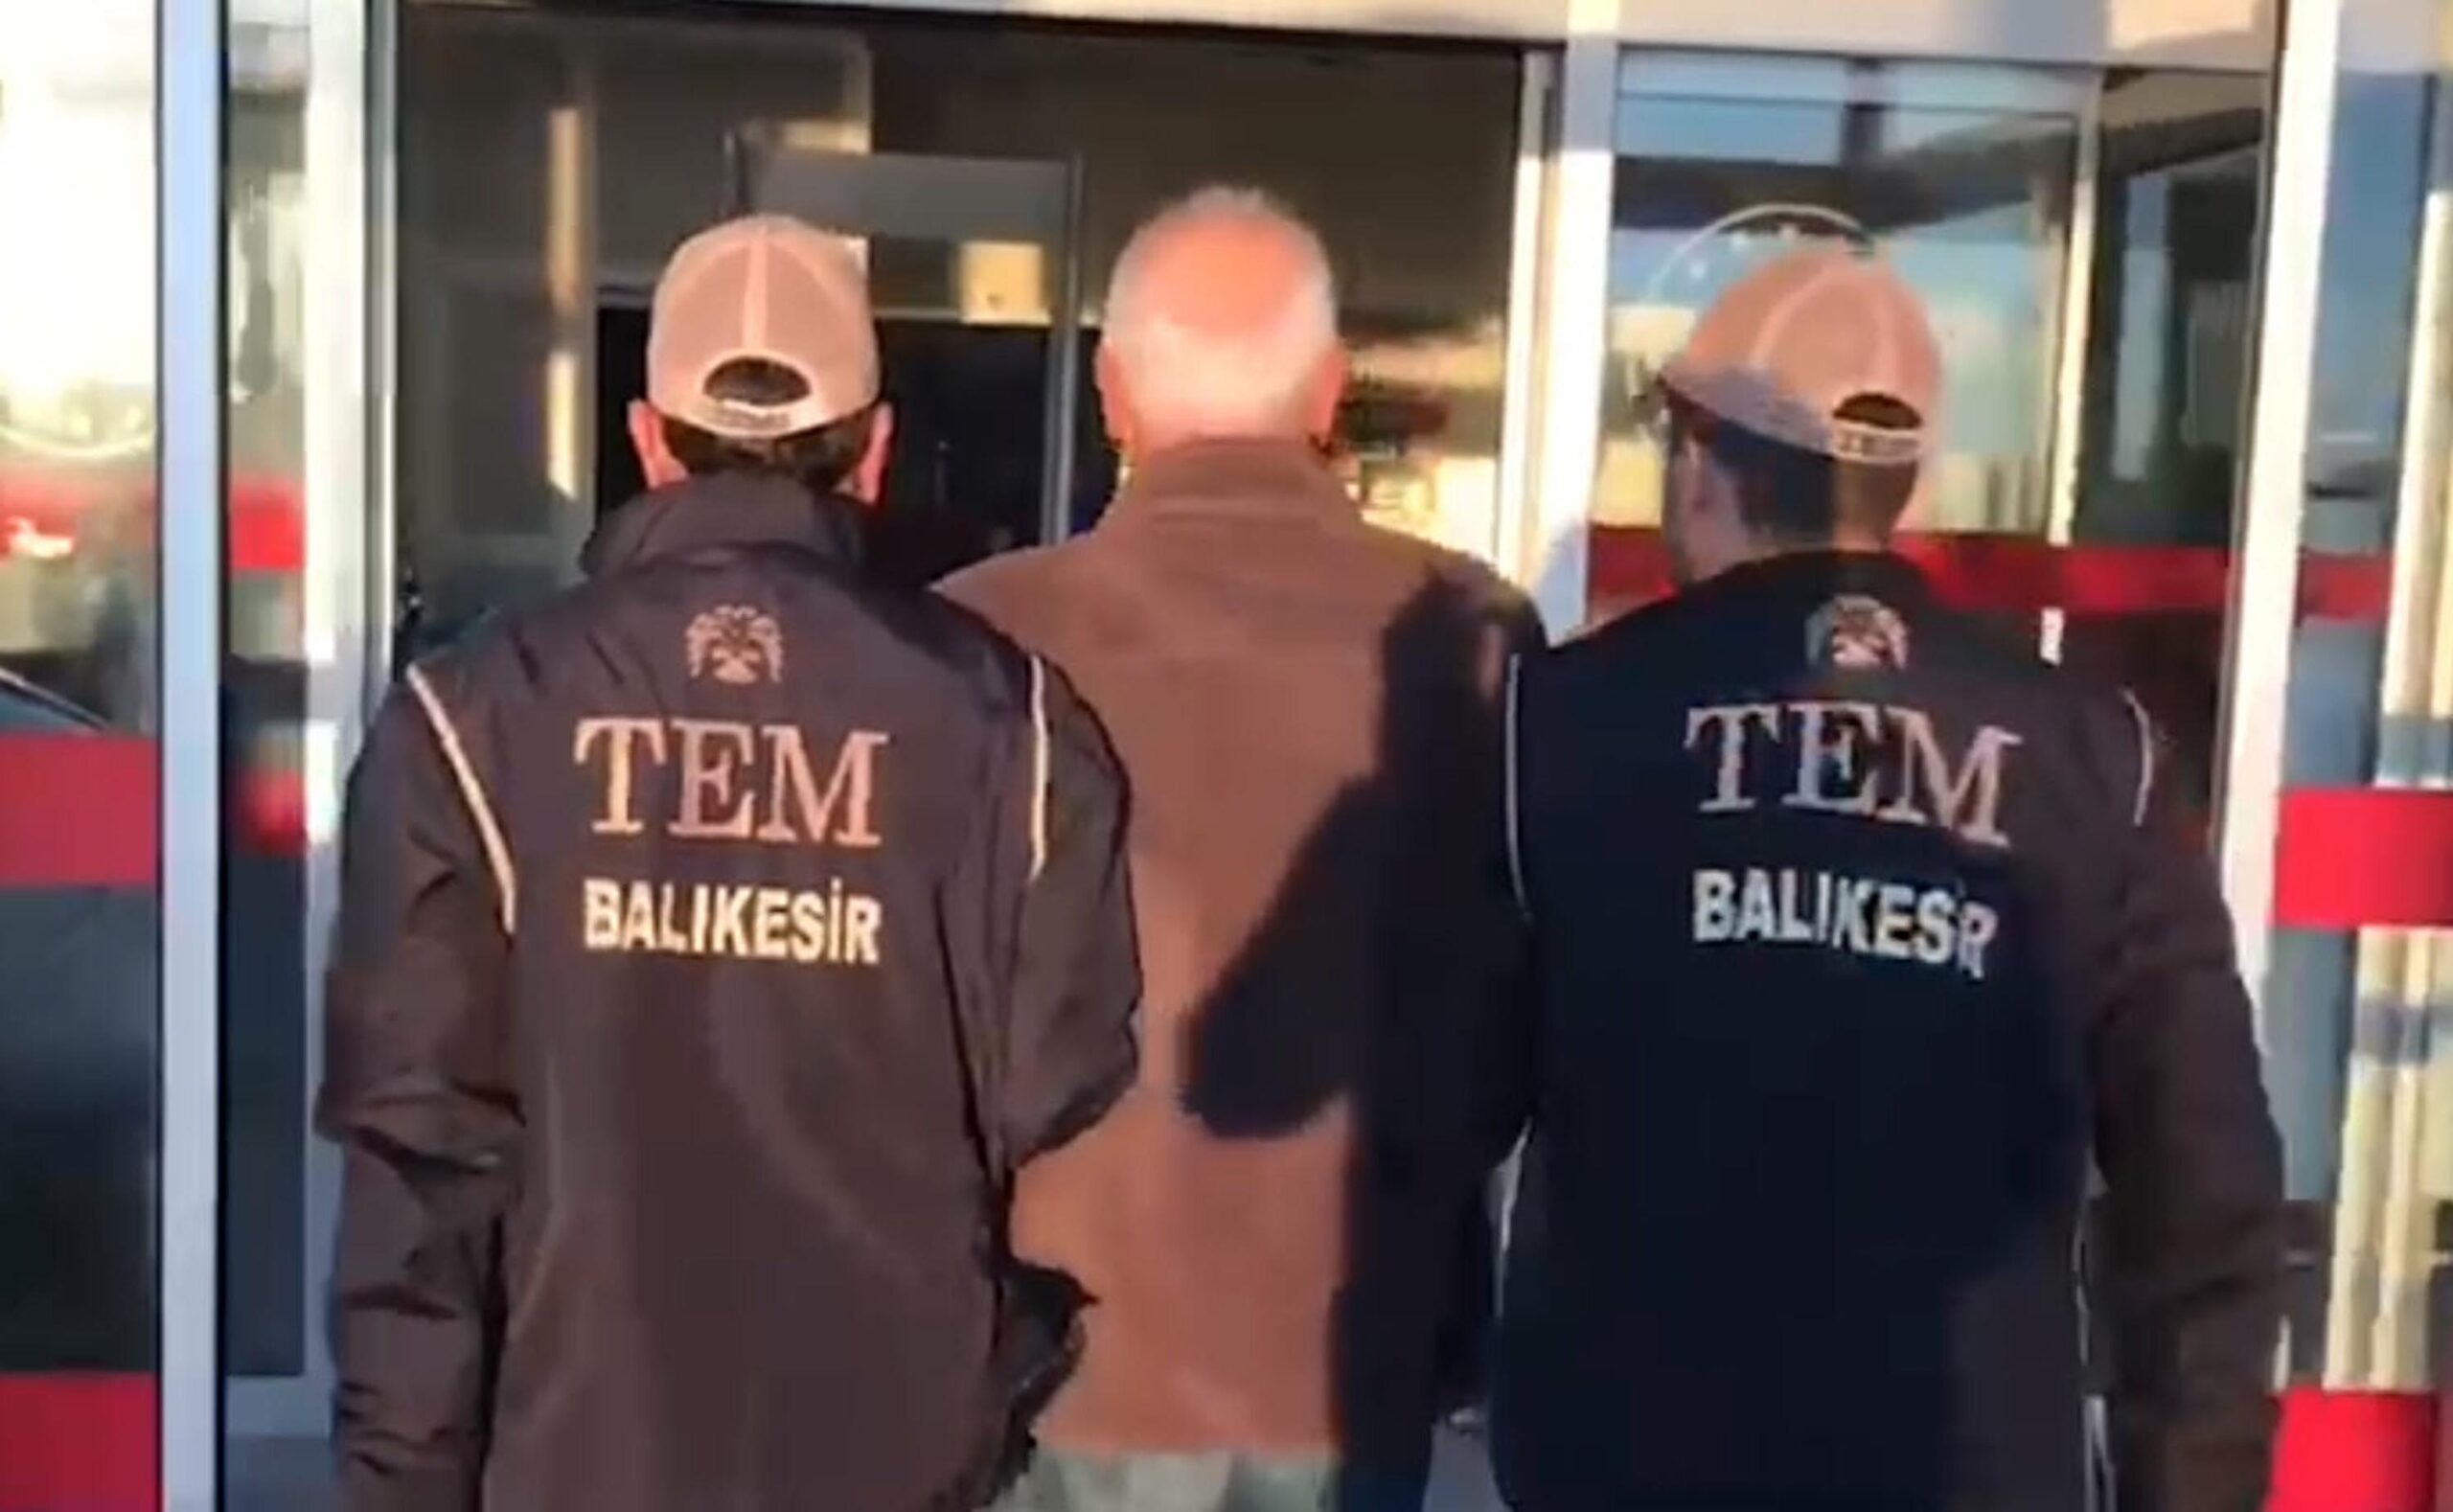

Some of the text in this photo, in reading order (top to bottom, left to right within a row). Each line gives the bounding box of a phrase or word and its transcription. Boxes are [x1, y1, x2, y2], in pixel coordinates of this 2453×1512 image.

[574, 717, 889, 846] TEM
[1684, 700, 2023, 848] TEM
[585, 877, 882, 964] BALIKESİR
[1692, 867, 1999, 979] BALIKESR
